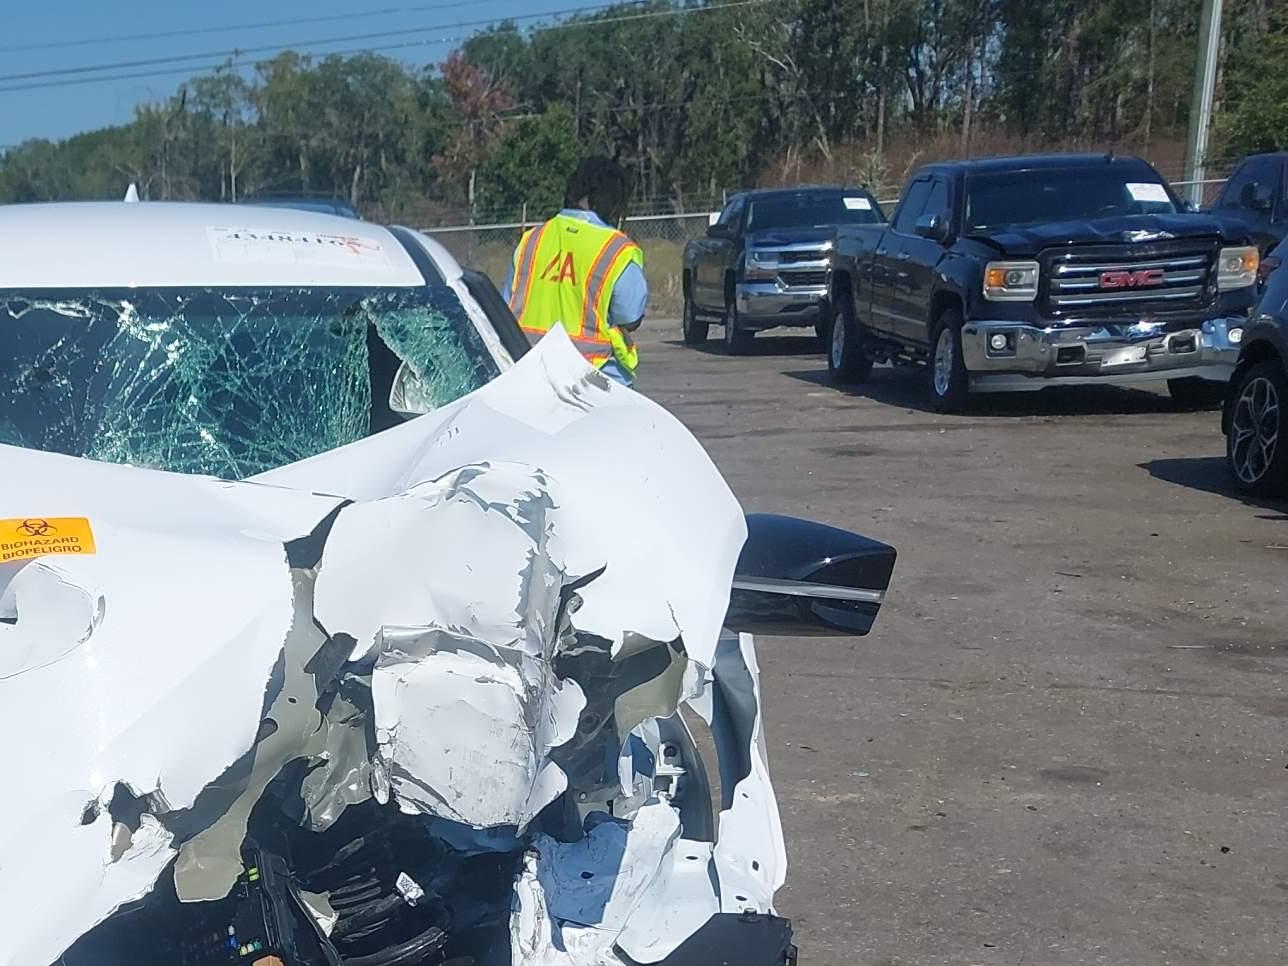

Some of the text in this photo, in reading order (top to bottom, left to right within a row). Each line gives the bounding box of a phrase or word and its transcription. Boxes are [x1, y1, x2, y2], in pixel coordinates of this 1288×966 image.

[1100, 269, 1165, 288] GMC
[1, 536, 79, 551] BIOHAZARD
[2, 545, 82, 560] BIOPELIGRO
